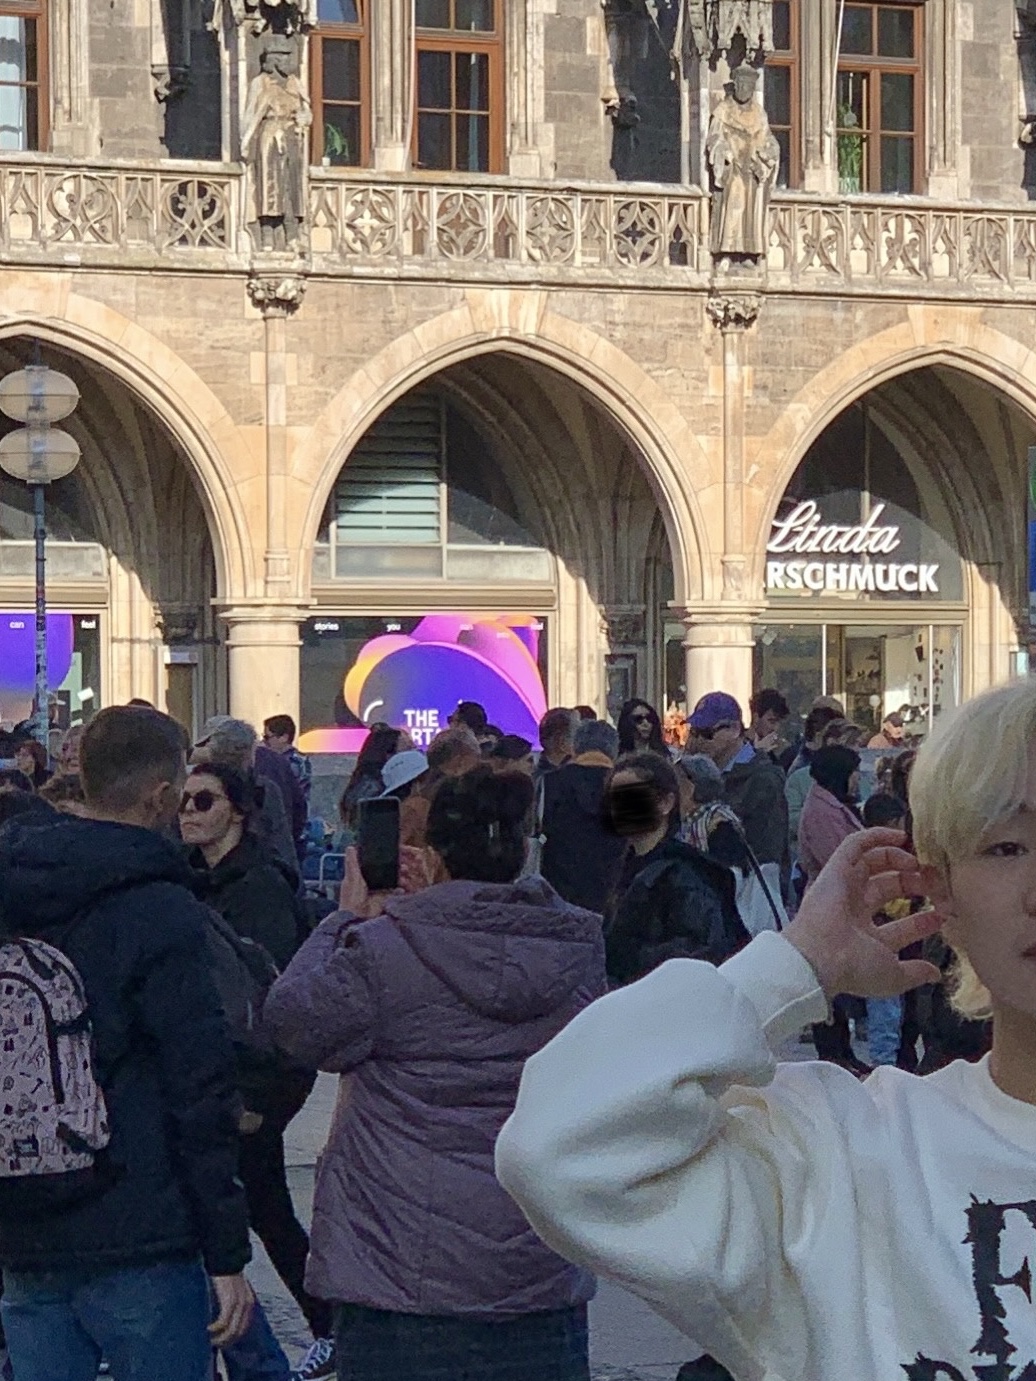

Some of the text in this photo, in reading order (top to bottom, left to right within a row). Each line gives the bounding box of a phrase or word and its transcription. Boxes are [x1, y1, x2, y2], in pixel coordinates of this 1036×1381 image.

[766, 500, 901, 554] Linda
[763, 561, 940, 592] RSCHMUCK
[314, 622, 339, 631] stories
[386, 624, 401, 632] you
[403, 709, 439, 727] THE
